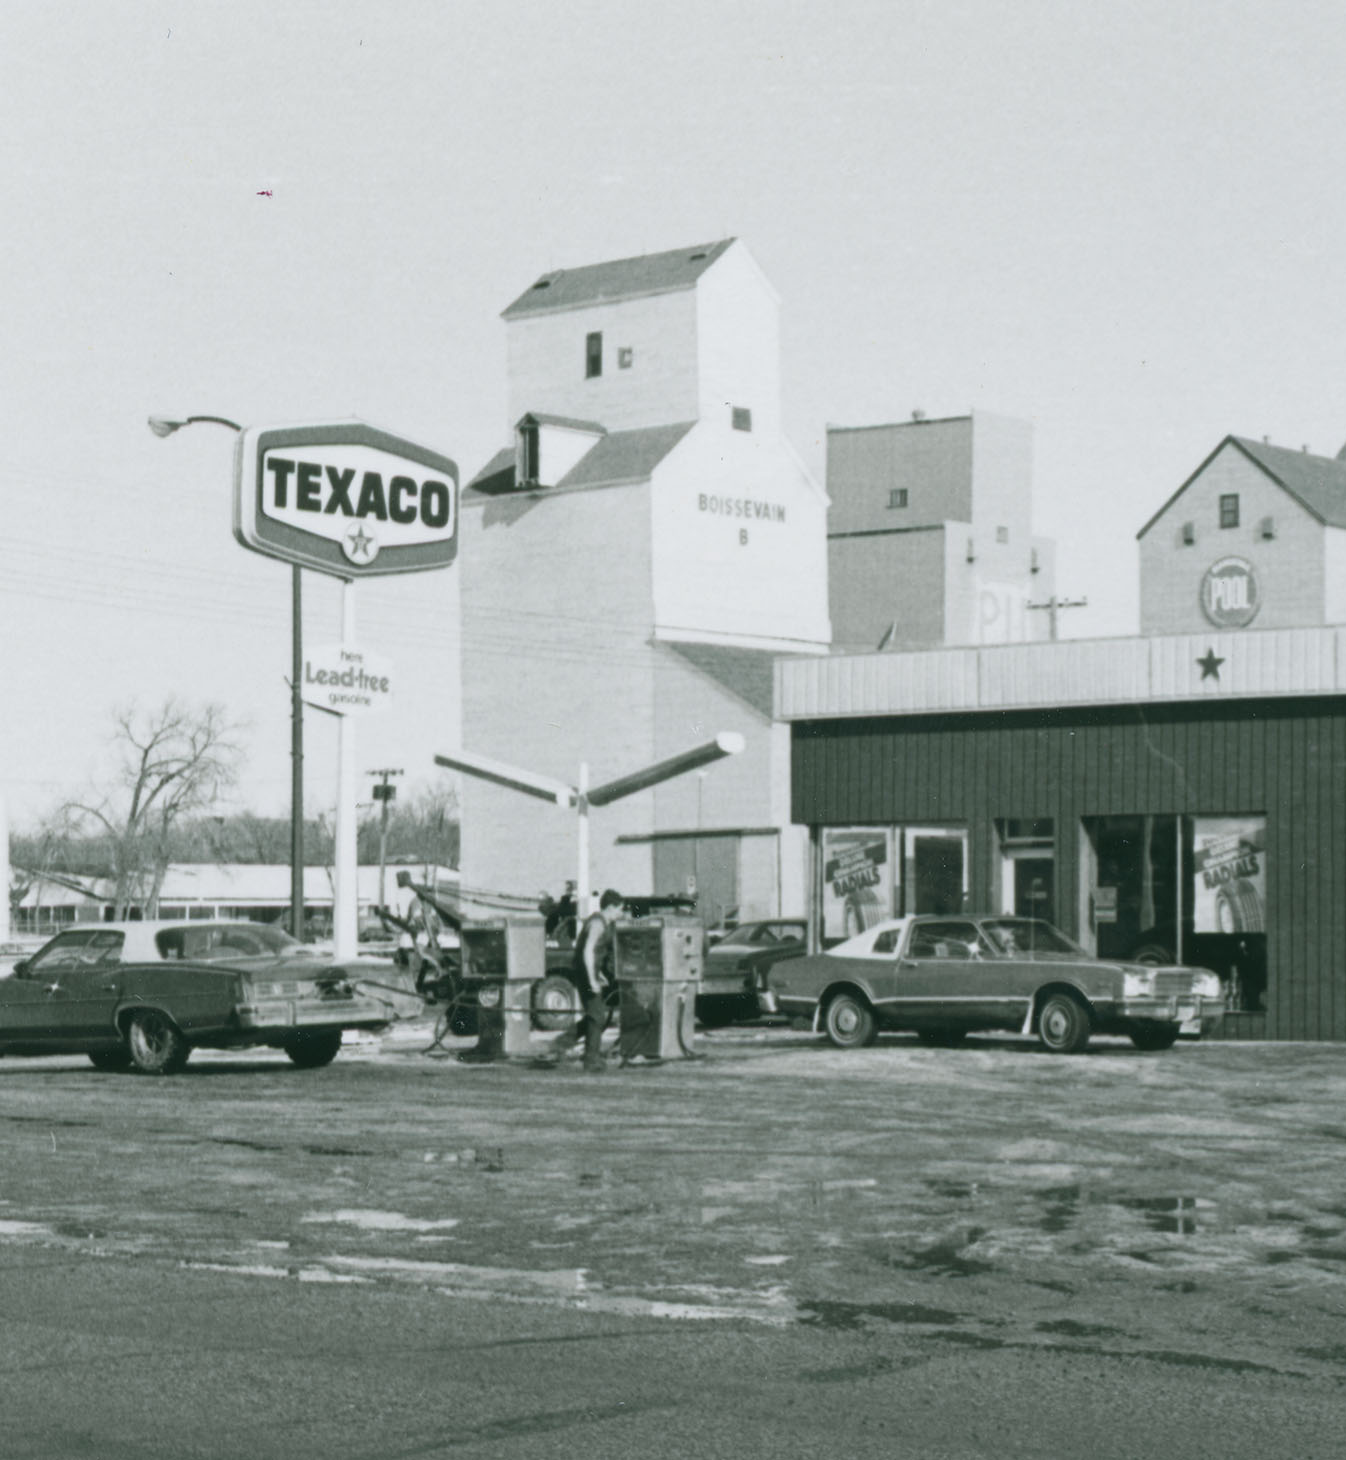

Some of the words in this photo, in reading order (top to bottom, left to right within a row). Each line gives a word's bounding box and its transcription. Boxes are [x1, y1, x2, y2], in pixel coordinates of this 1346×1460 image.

[267, 457, 450, 529] TEXACO
[698, 493, 786, 523] BOISSEVAIN
[739, 528, 749, 546] B
[832, 864, 882, 899] RADIALS
[1203, 854, 1260, 891] RADIALS
